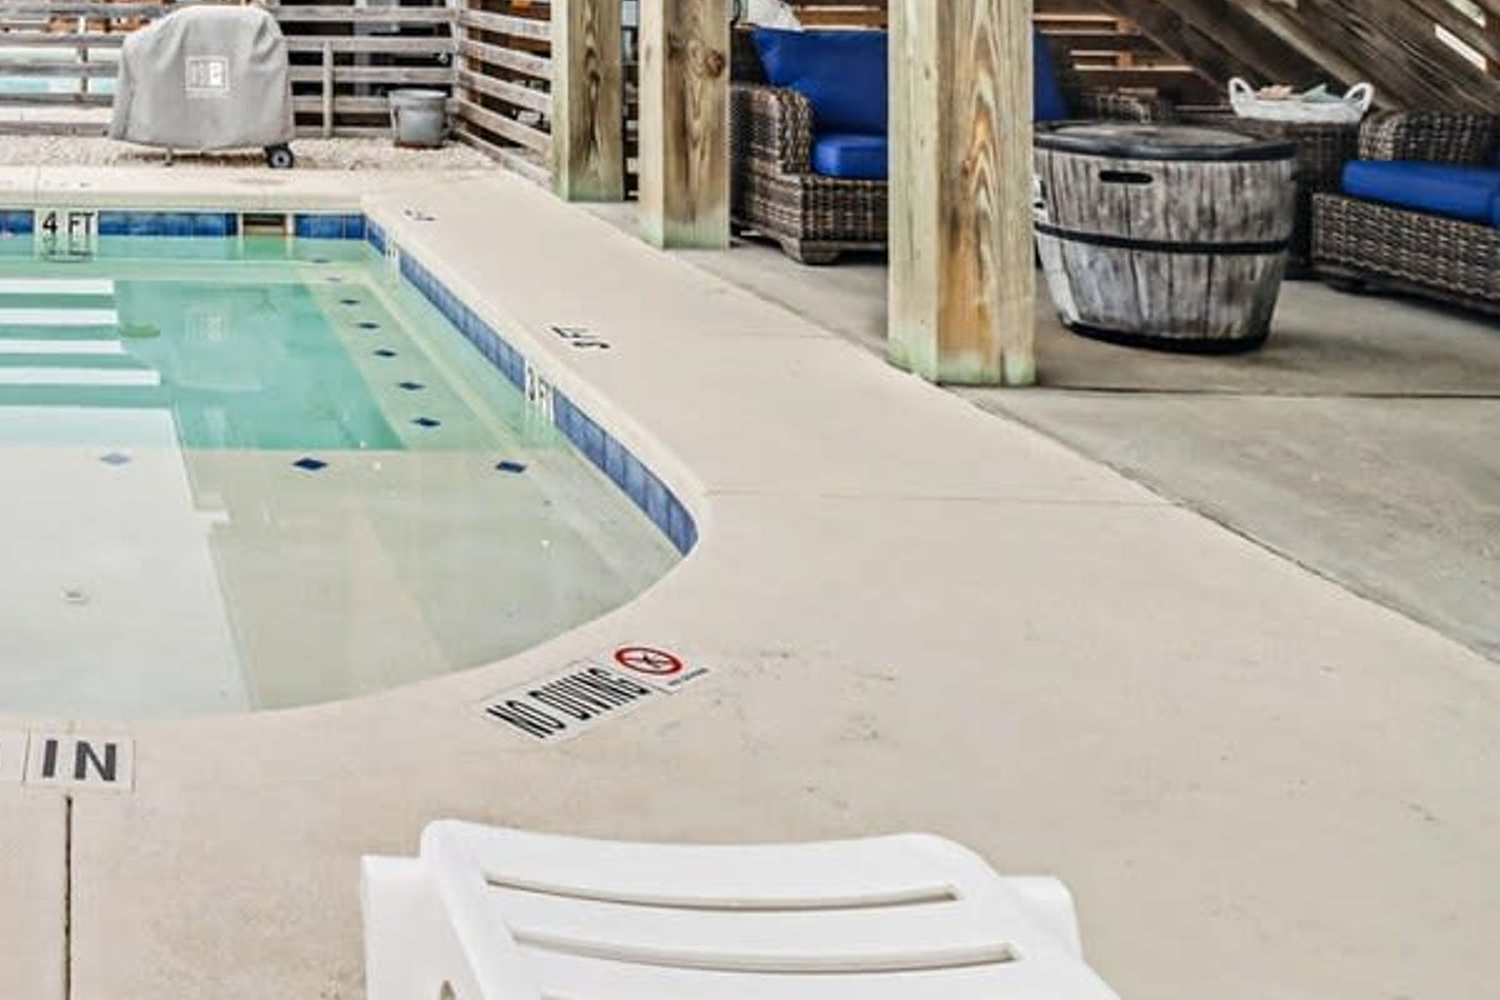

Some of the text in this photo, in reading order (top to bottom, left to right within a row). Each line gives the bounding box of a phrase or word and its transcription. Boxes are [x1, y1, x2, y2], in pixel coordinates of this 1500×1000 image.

[42, 209, 95, 236] 4 FT
[485, 700, 567, 739] NO
[527, 667, 652, 722] DIVING
[41, 738, 117, 782] IN
